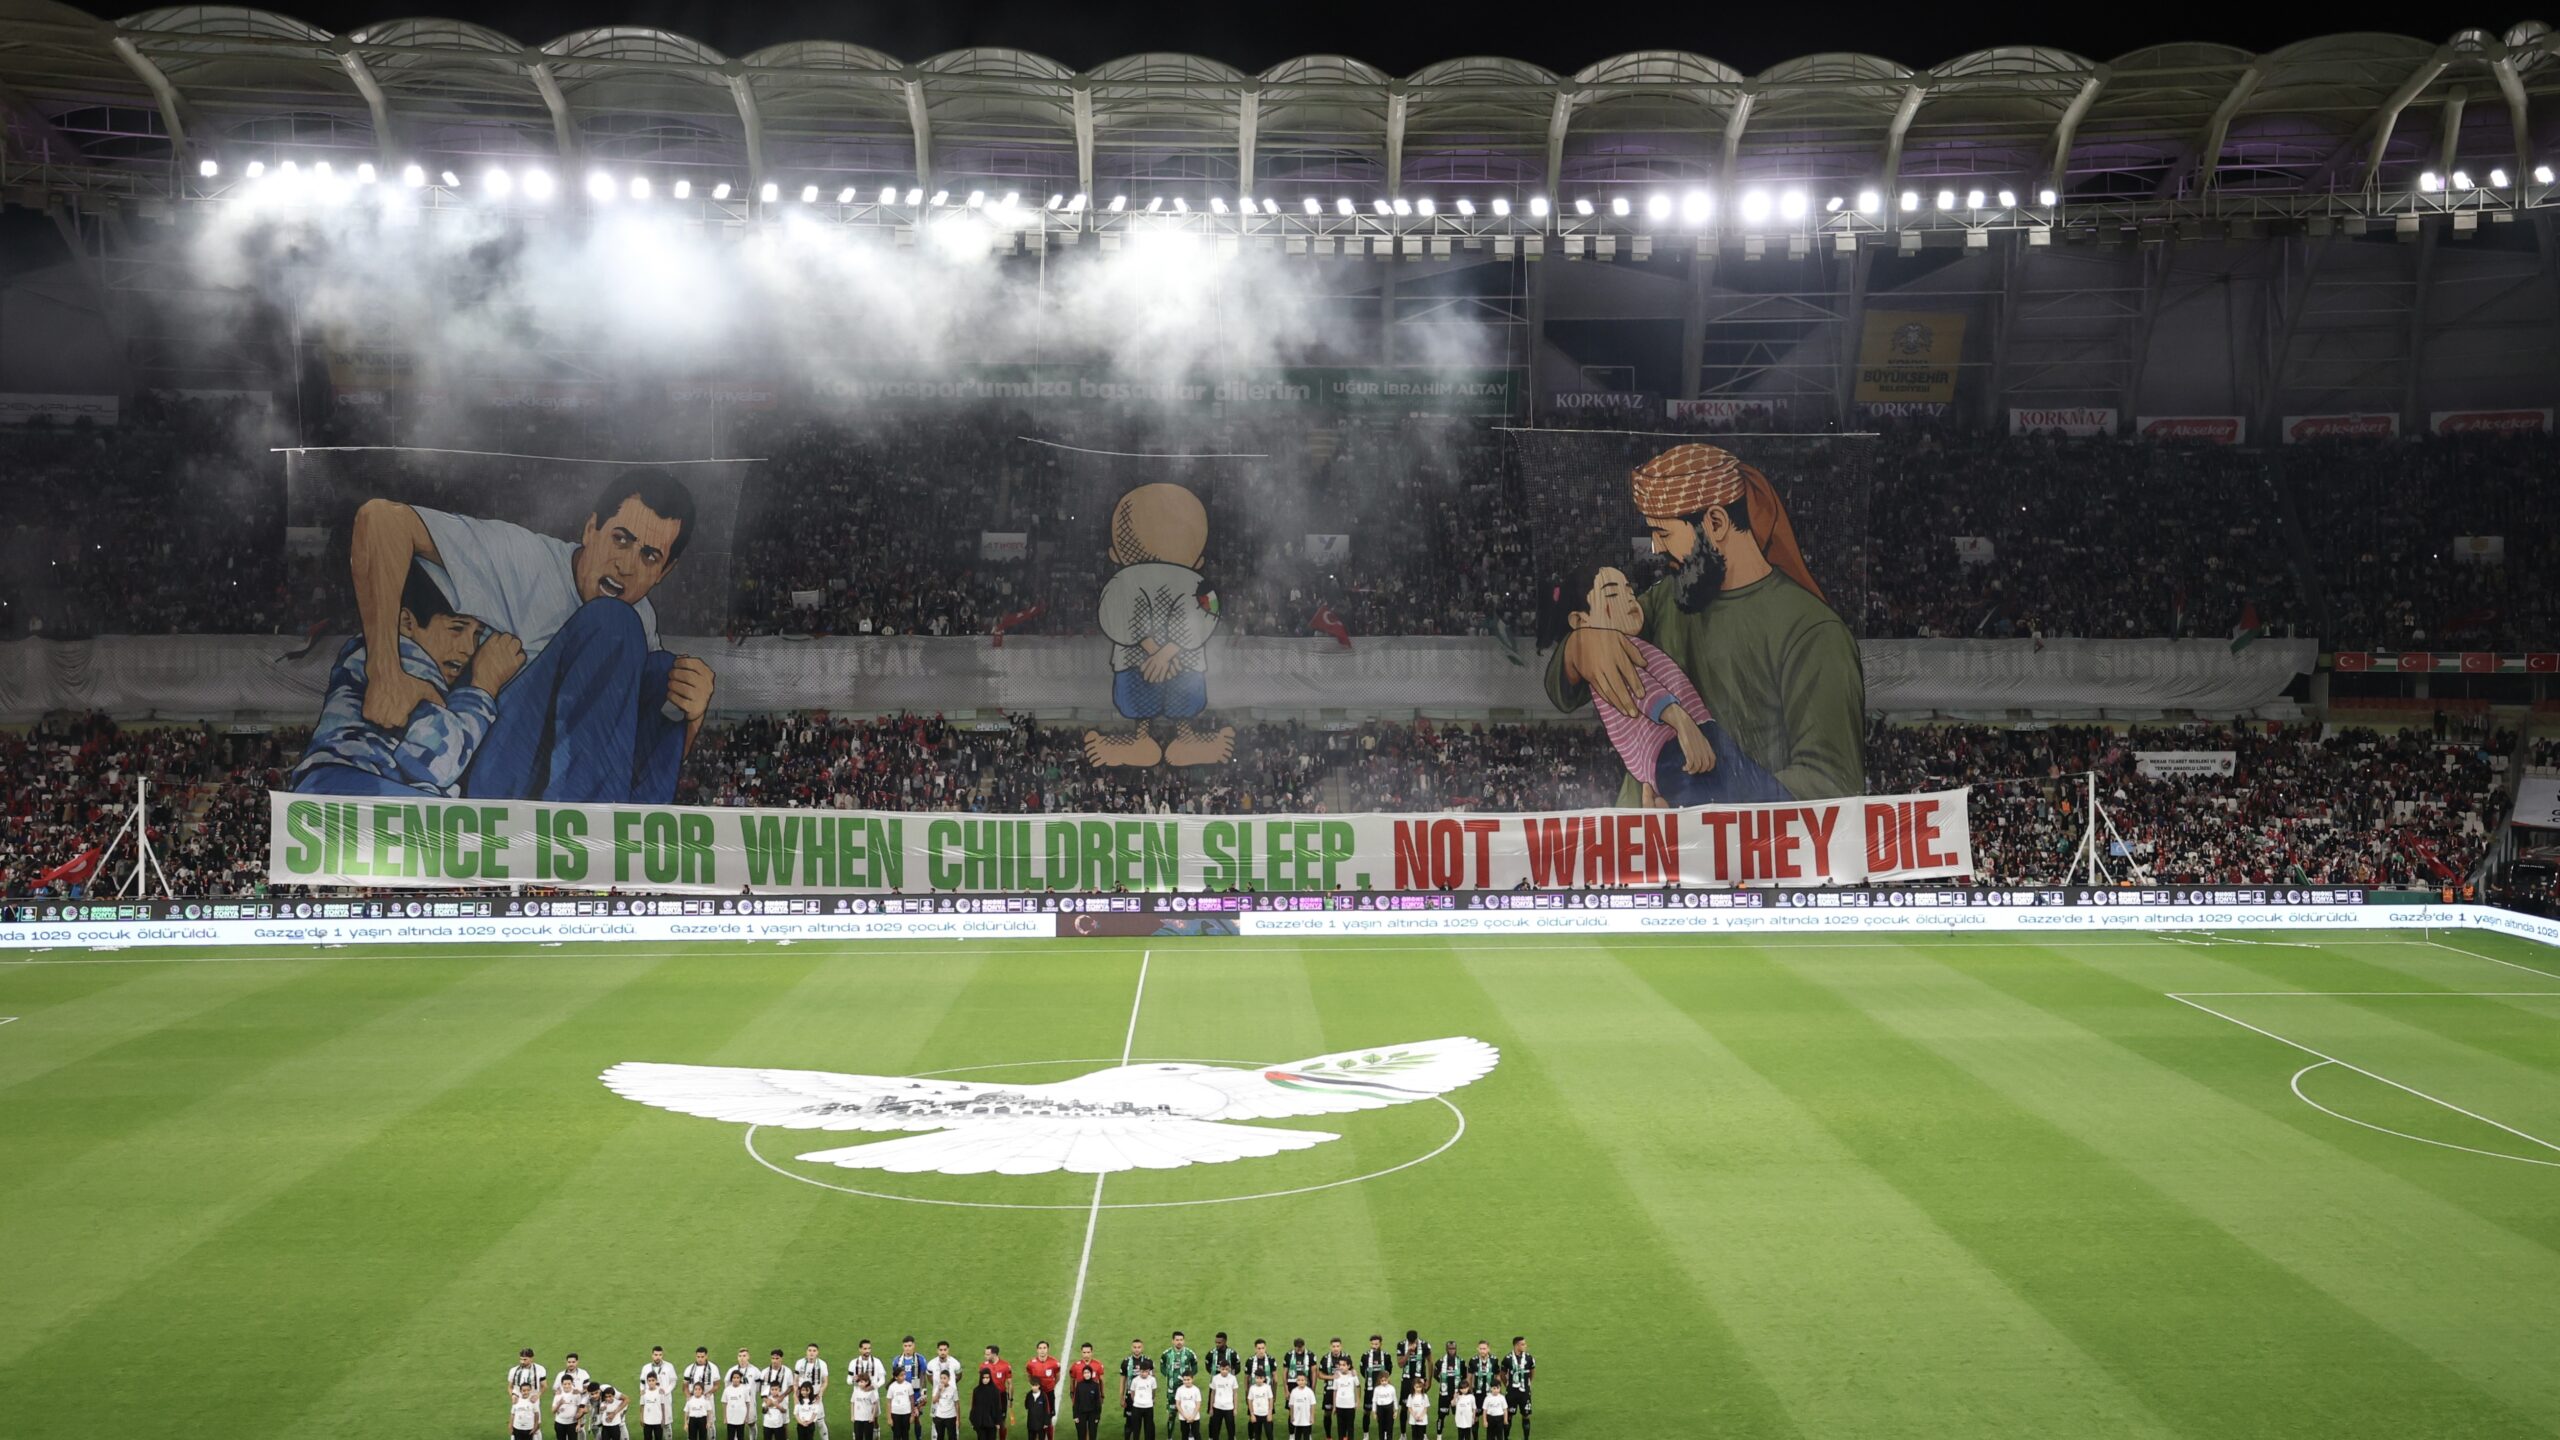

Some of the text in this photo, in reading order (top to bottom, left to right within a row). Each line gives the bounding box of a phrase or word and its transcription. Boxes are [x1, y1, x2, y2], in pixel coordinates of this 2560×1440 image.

[1863, 367, 1948, 384] BÜYÜKŞEHİR
[1214, 379, 1309, 402] dilerim
[1332, 379, 1508, 396] UĞUR İBRAHİM ALTAY
[1556, 393, 1644, 409] KORKMAZ
[2019, 411, 2108, 427] KORKMAZ
[2171, 425, 2234, 438] Akseker
[286, 801, 509, 878] SILENCE
[535, 808, 588, 881] IS
[613, 812, 715, 883] FOR
[741, 815, 903, 888] WHEN
[928, 819, 1178, 890] CHILDREN
[1394, 819, 1500, 889] NOT
[1523, 814, 1680, 887] WHEN
[1702, 806, 1840, 881] THEY
[1864, 800, 1958, 873] DIE.
[1255, 919, 1324, 929] Gazze'de
[1328, 919, 1336, 929] 1
[1342, 921, 1382, 931] yaşın
[1386, 918, 1439, 928] altında
[1443, 918, 1479, 928] 1029
[1483, 918, 1529, 929] çocuk
[1640, 916, 1707, 926] Gazze'de
[1712, 916, 1720, 926] 1
[1726, 918, 1765, 928] yaşın
[1769, 915, 1820, 925] altında
[1824, 915, 1860, 925] 1029
[1863, 915, 1910, 927] çocuk
[2017, 913, 2083, 924] Gazze'de
[2087, 914, 2096, 924] 1
[2100, 916, 2140, 926] yaşın
[2143, 913, 2194, 924] altında
[2198, 913, 2233, 923] 1029
[2237, 913, 2284, 925] çocuk
[2388, 911, 2559, 938] Gazze'de 1 yaşın altında 1029
[30, 930, 72, 942] 1029
[76, 929, 132, 943] çocuk
[253, 926, 328, 938] Gazze'de
[333, 927, 343, 938] 1
[348, 929, 393, 940] yaşın
[397, 925, 453, 937] altında
[457, 925, 497, 936] 1029
[501, 925, 553, 938] çocuk
[669, 922, 741, 934] Gazze'de
[746, 923, 755, 934] 1
[760, 925, 803, 936] yaşın
[807, 922, 861, 933] altında
[865, 922, 903, 933] 1029
[907, 922, 957, 934] çocuk
